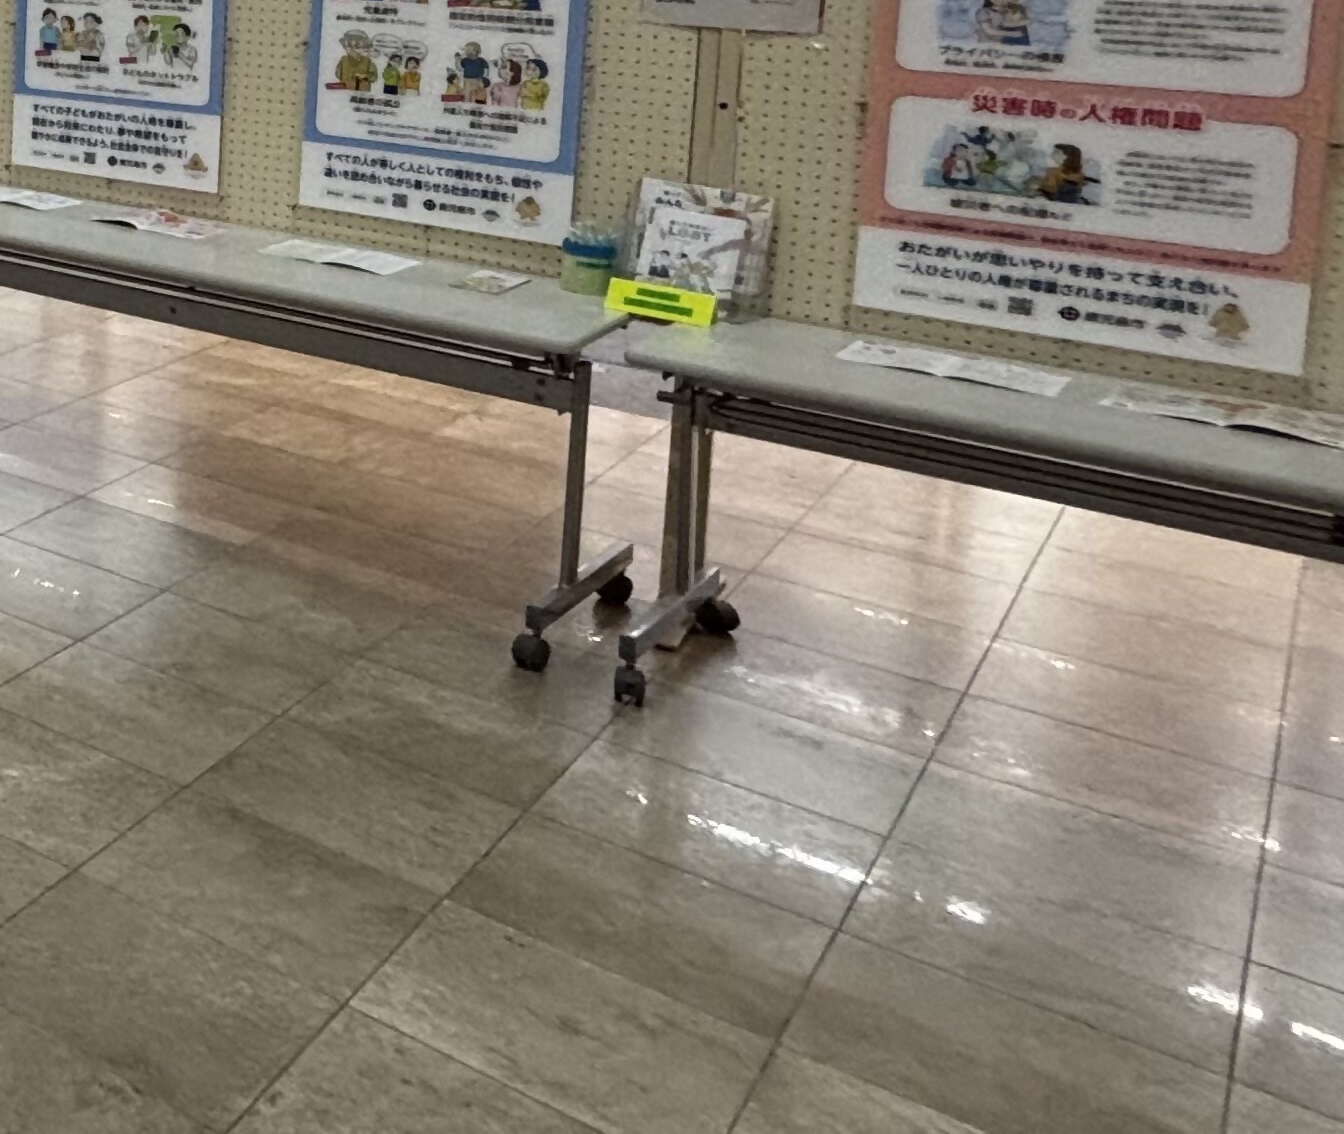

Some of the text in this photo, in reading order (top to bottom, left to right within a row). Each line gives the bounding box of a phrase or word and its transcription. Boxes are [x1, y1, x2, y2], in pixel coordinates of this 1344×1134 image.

[971, 93, 1204, 132] 災害時の人権問題
